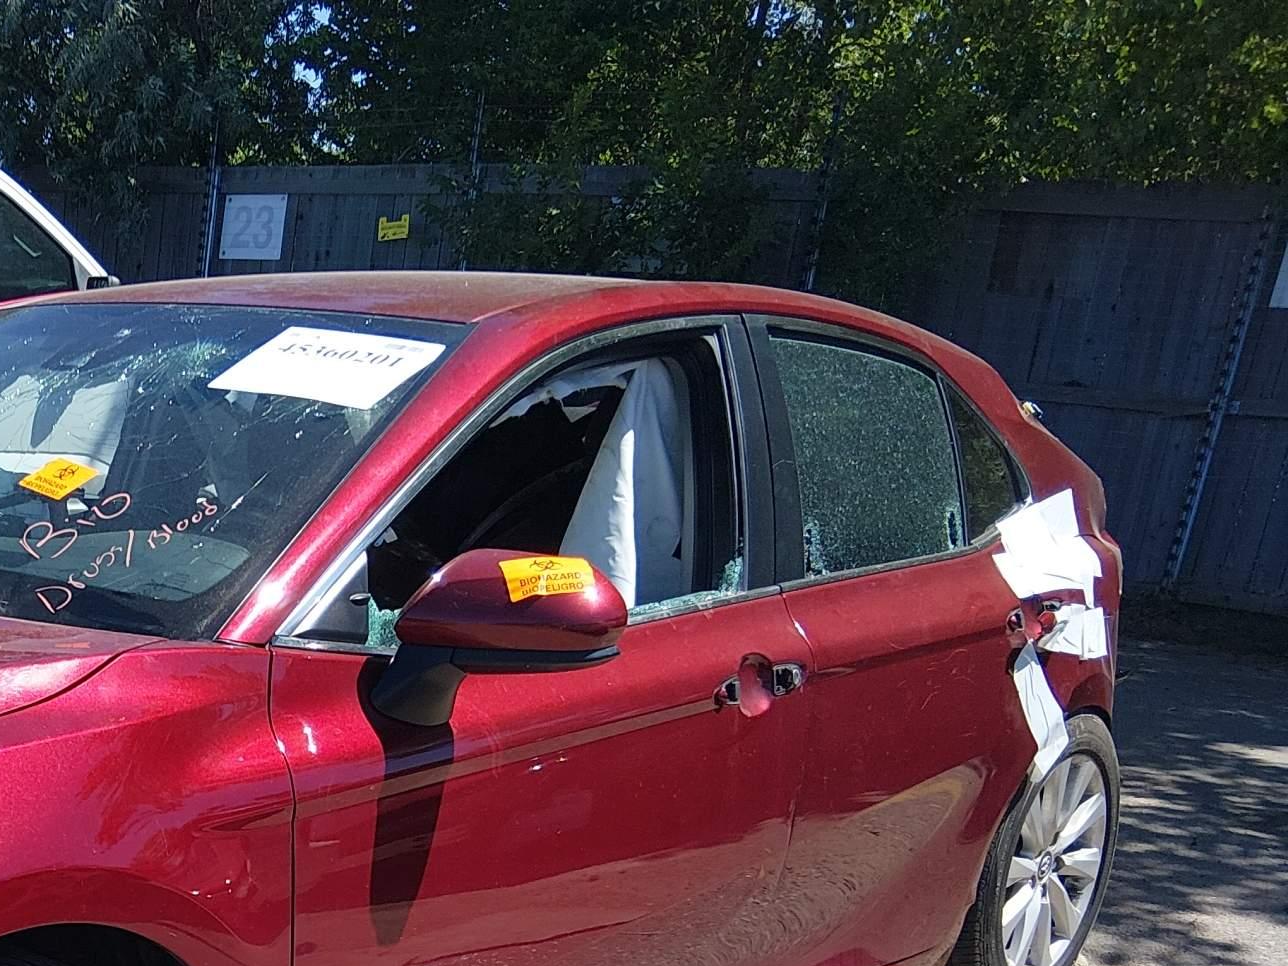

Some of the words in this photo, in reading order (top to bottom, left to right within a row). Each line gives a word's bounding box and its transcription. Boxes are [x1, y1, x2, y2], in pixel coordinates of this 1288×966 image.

[229, 206, 274, 249] 23
[279, 343, 404, 367] 45360201
[519, 571, 582, 588] BIOHAZARD
[521, 581, 585, 596] BIOPELIGRO
